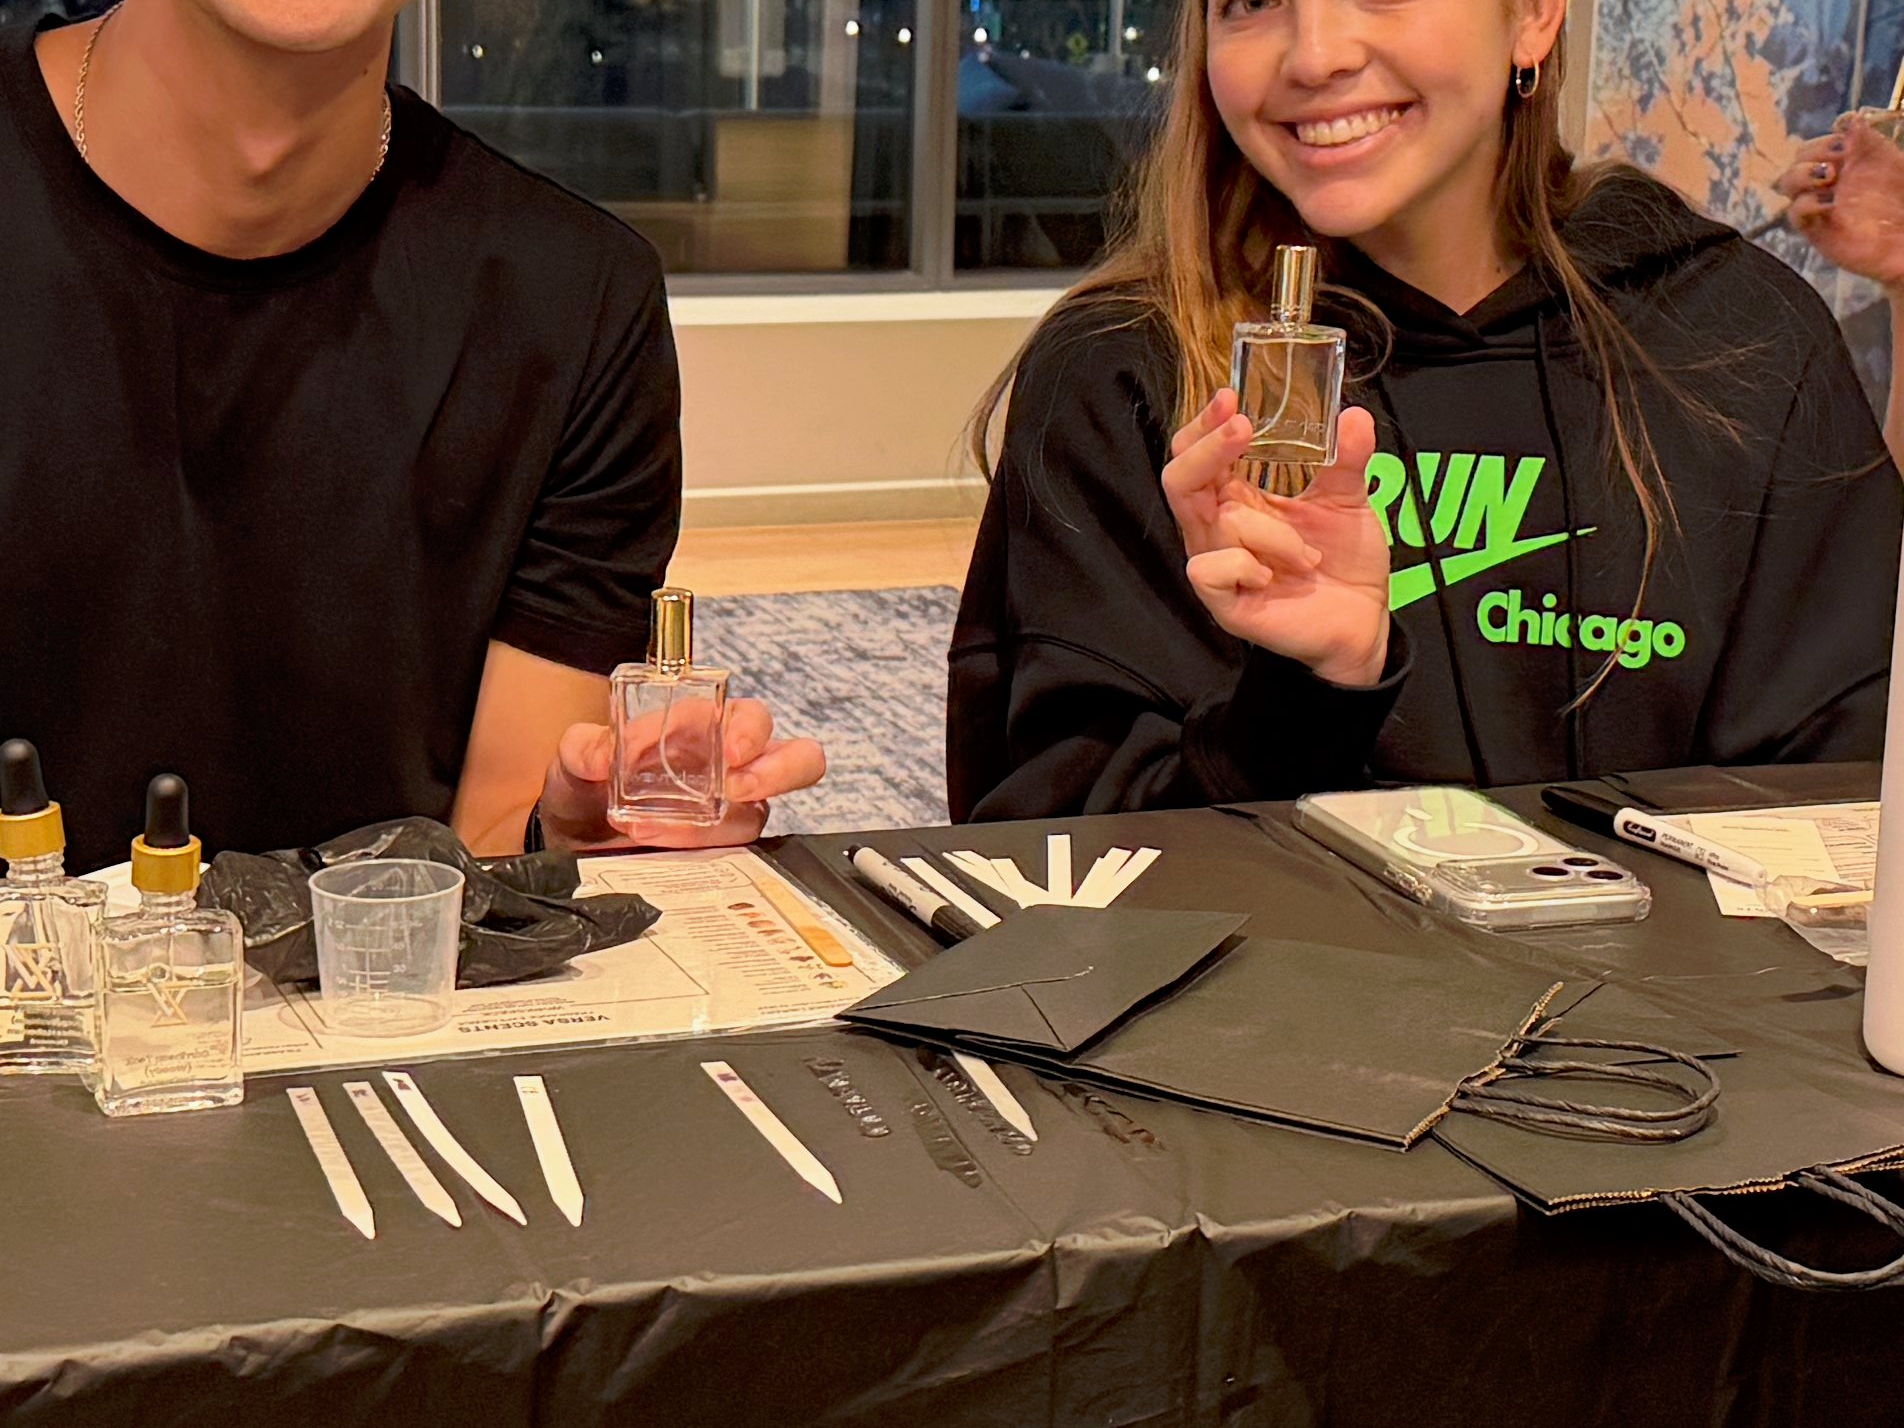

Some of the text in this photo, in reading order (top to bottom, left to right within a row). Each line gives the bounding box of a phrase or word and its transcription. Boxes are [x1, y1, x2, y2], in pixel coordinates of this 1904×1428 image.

[1365, 452, 1546, 549] RUN
[1476, 589, 1686, 669] Chicago
[458, 1014, 610, 1033] VERSA SCENTS
